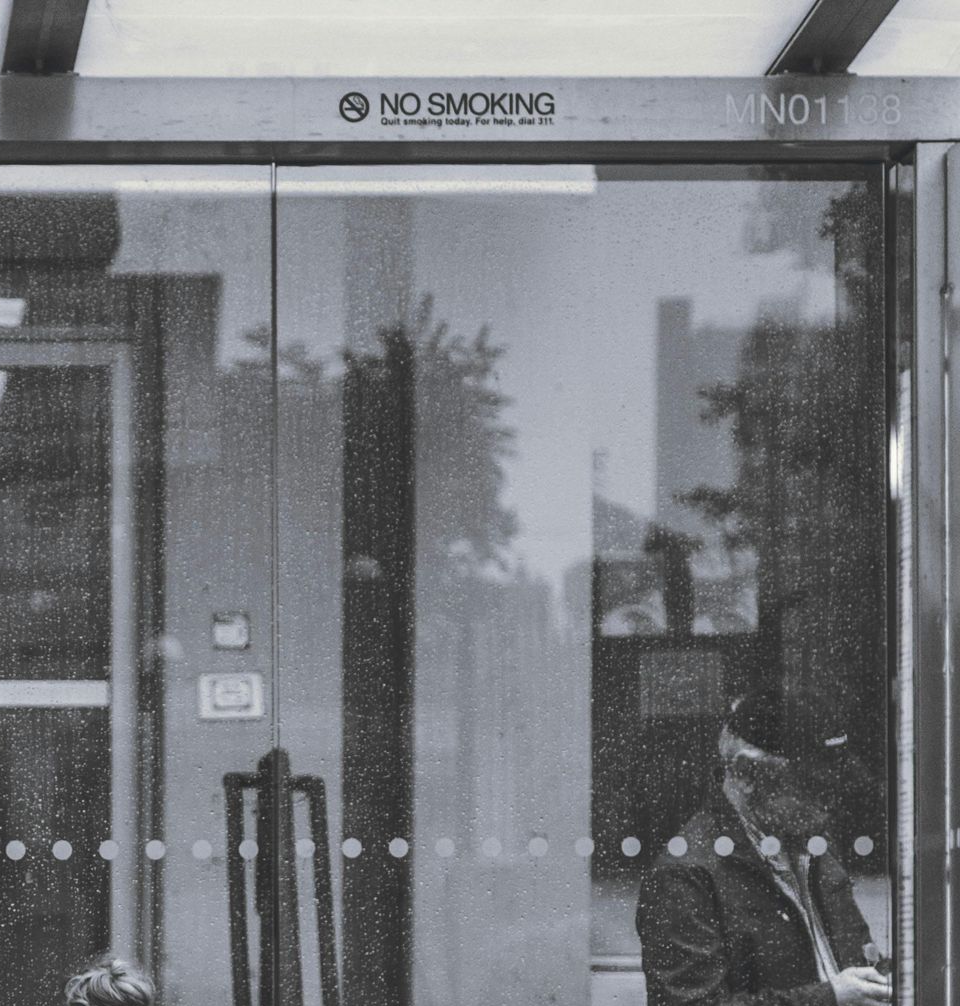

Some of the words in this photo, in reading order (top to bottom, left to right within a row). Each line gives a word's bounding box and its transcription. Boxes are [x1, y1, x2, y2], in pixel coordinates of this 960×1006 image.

[380, 92, 421, 116] NO
[427, 92, 555, 116] SMOKING
[725, 93, 902, 125] MN01138
[380, 116, 401, 126] Quit
[403, 117, 443, 127] smoking
[445, 117, 472, 127] today.
[475, 117, 490, 125] For
[518, 117, 535, 125] dial
